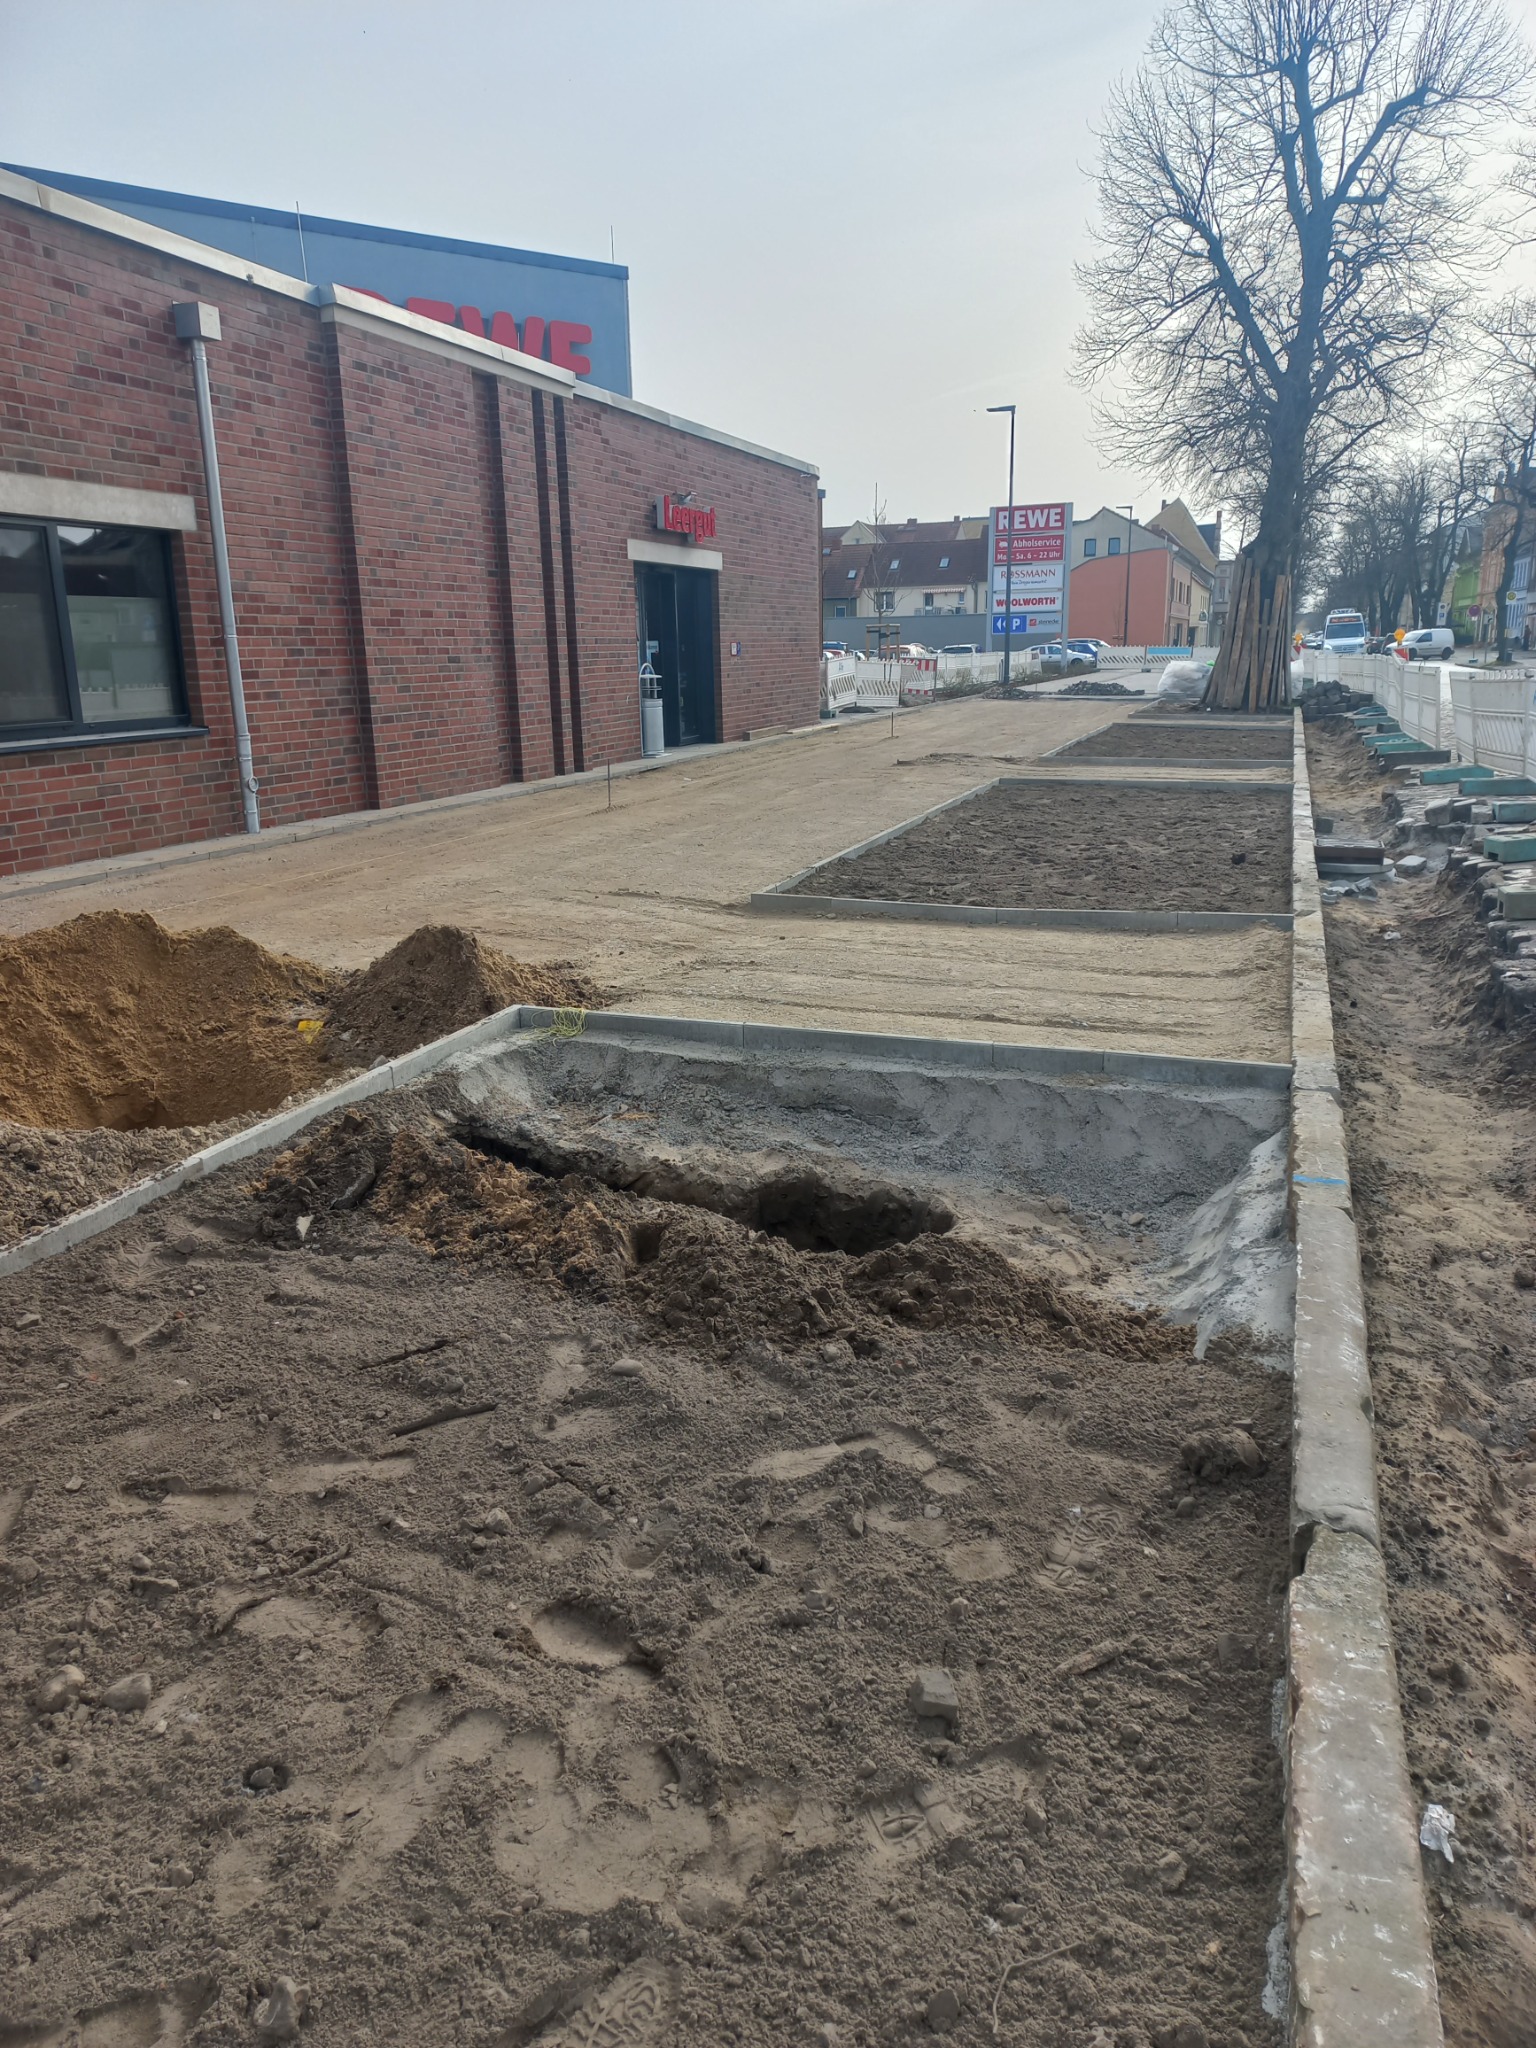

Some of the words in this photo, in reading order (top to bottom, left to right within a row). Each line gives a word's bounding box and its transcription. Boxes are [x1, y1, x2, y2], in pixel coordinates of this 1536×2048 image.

[344, 286, 592, 375] WE
[664, 495, 716, 543] Leergut
[998, 508, 1061, 530] REWE
[1012, 538, 1061, 548] Abholservice
[1048, 550, 1061, 558] Uhr
[996, 596, 1056, 607] WOLWORTH
[1012, 618, 1021, 631] P
